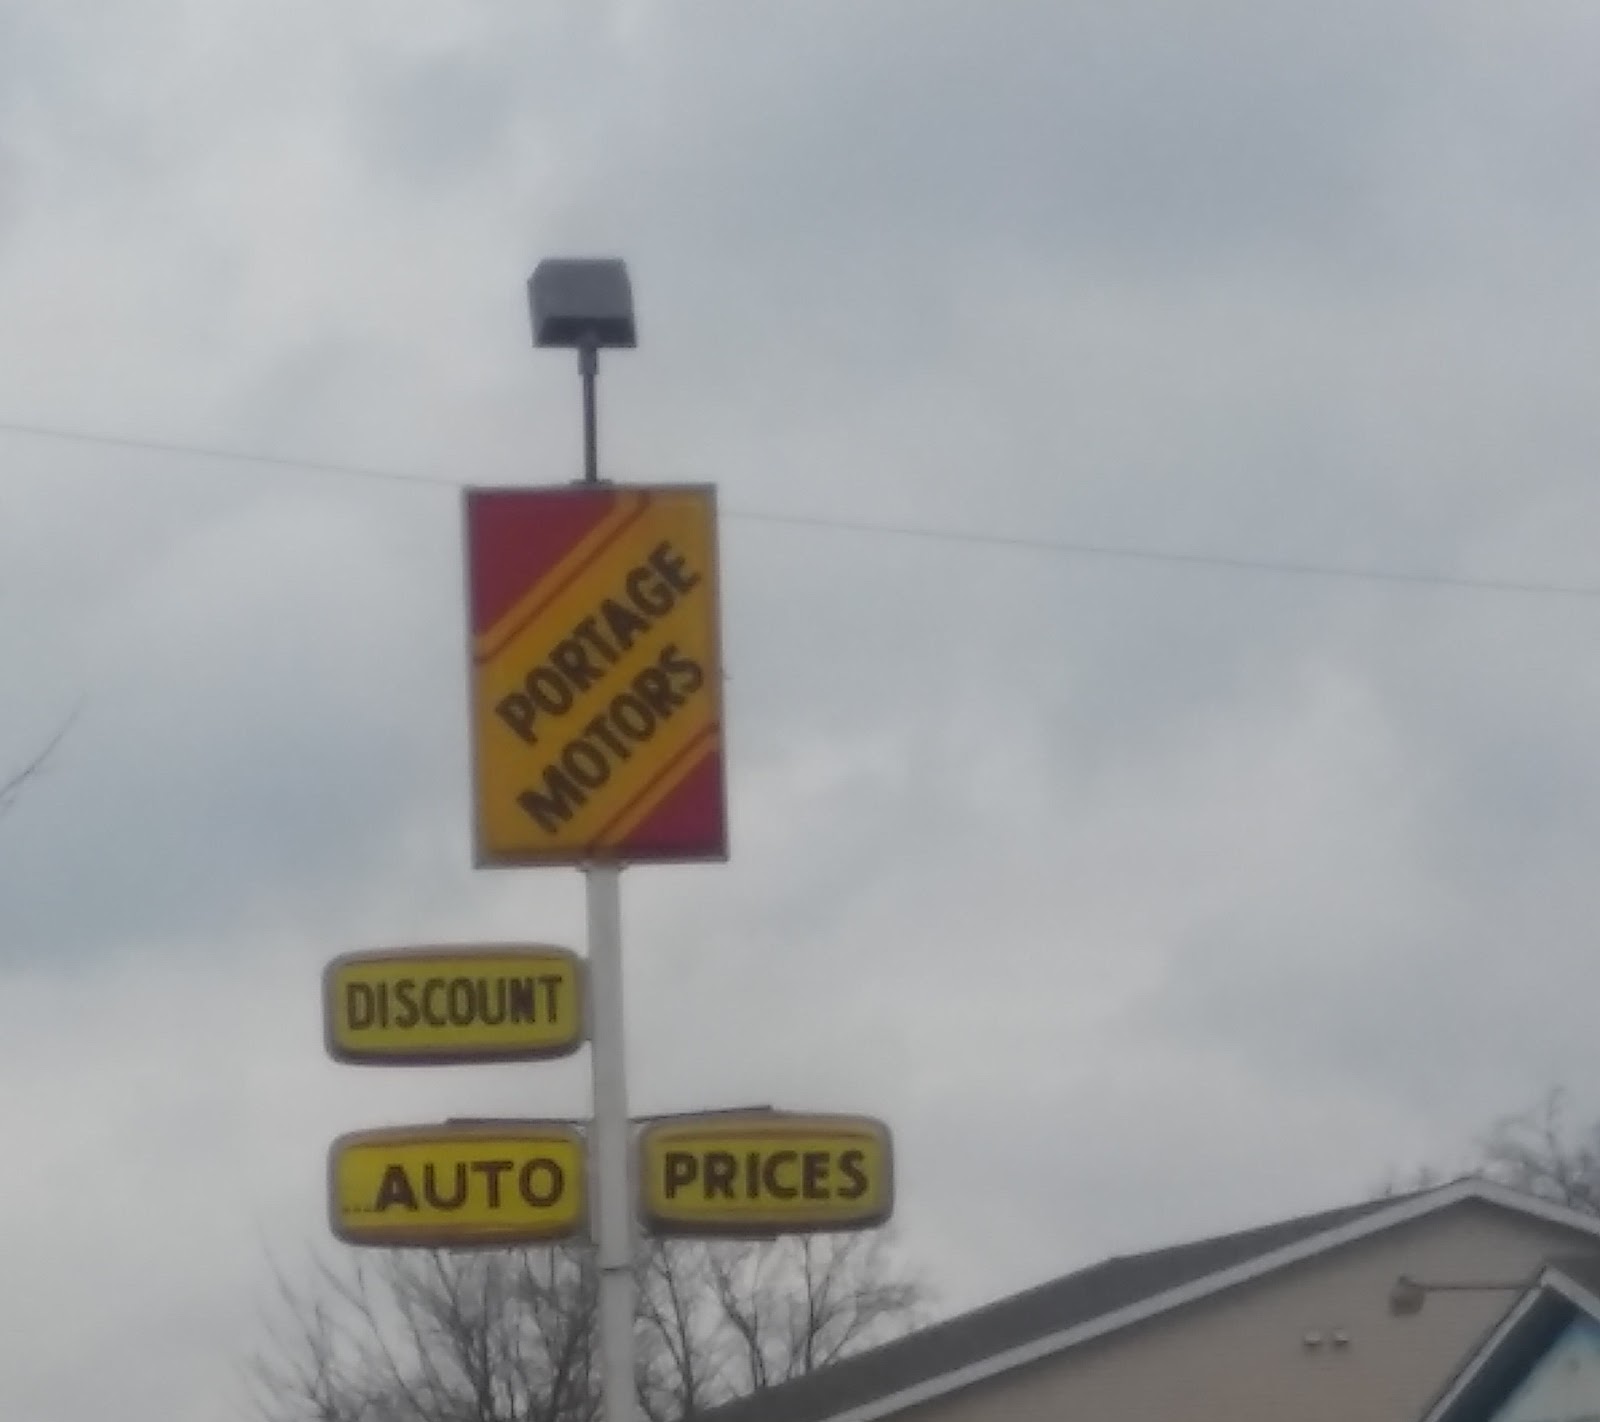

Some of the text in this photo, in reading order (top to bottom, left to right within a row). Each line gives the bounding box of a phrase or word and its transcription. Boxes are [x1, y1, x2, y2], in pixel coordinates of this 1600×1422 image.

[495, 540, 701, 747] PORTAGE
[516, 643, 704, 834] MOTORS
[346, 973, 563, 1031] DISCOUNT
[664, 1149, 869, 1200] PRICES
